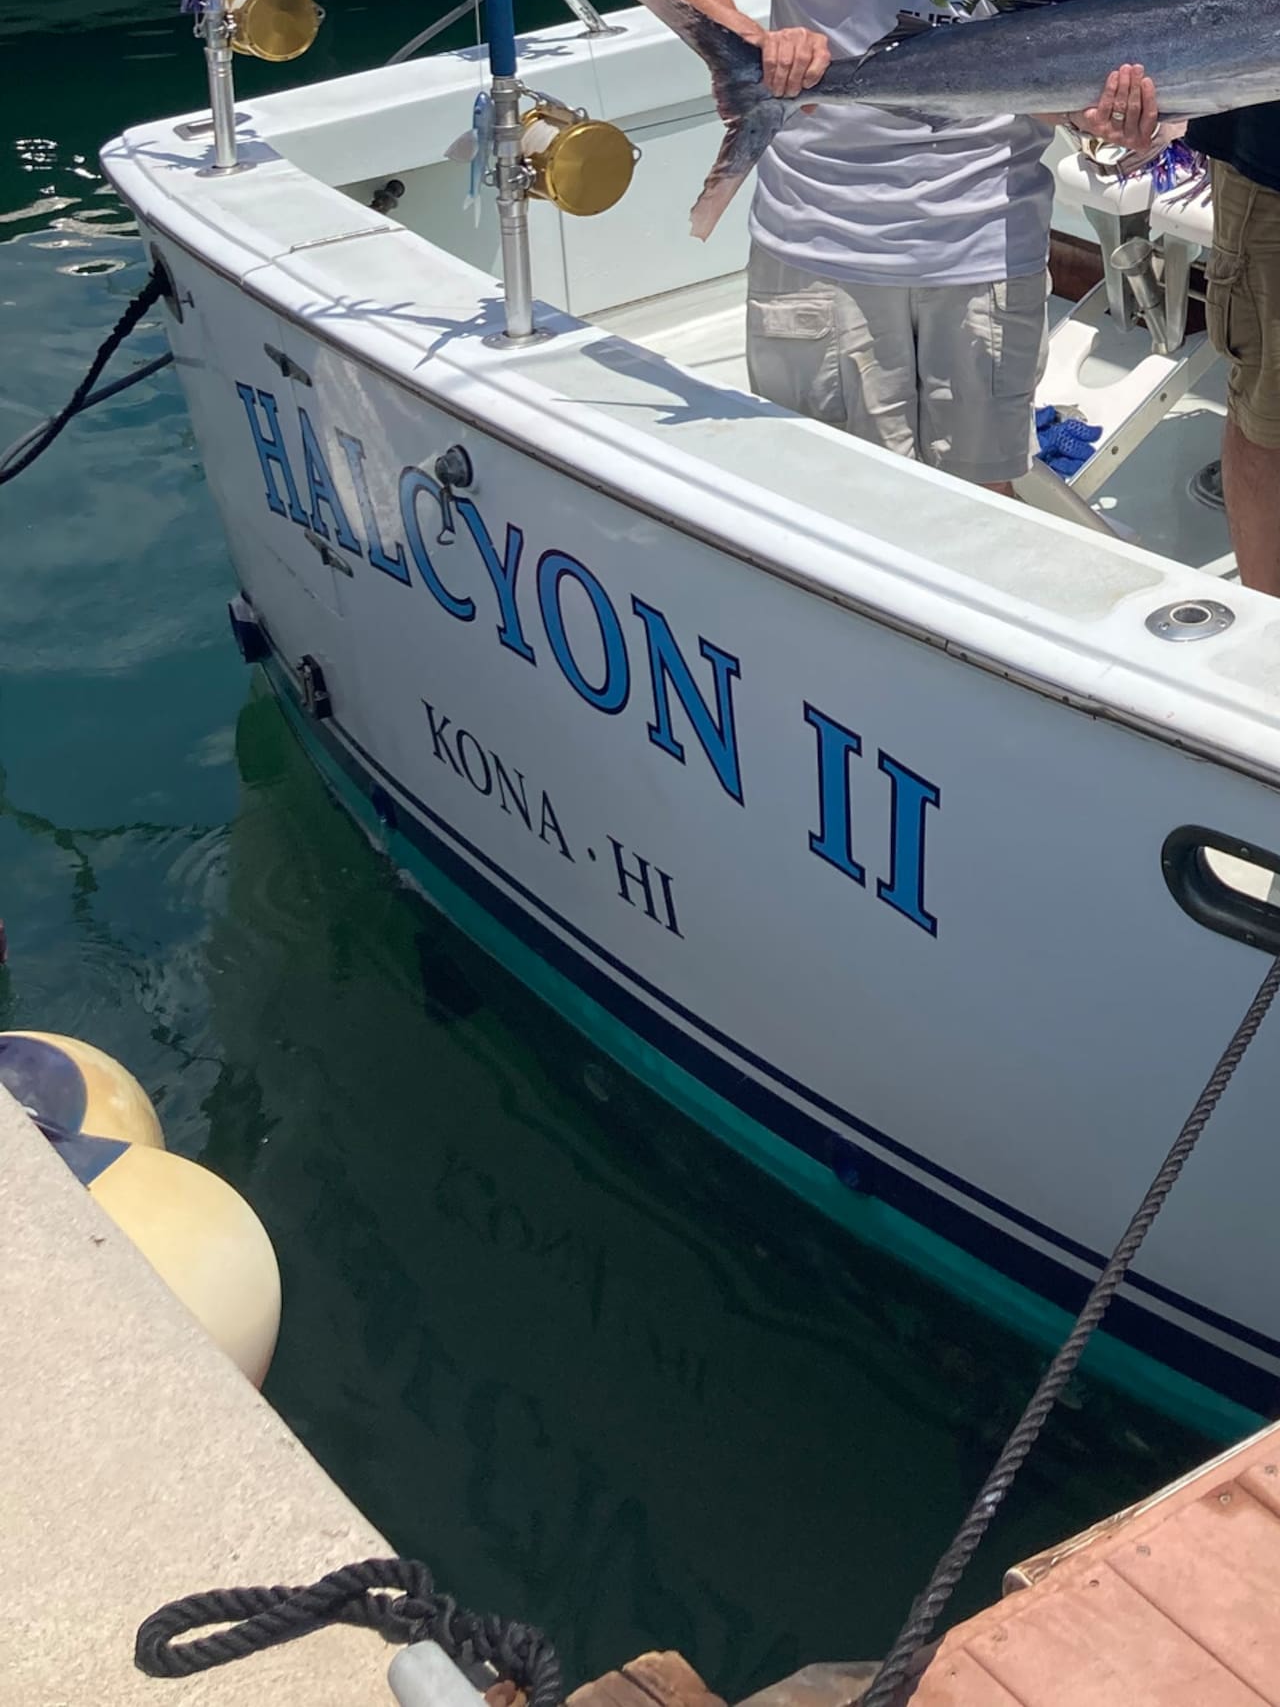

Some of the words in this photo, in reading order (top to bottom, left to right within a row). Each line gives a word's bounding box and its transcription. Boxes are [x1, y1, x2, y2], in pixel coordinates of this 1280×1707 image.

[235, 380, 745, 808] HALCYON
[803, 700, 942, 938] II
[421, 698, 575, 864] KONA
[607, 835, 685, 940] HI
